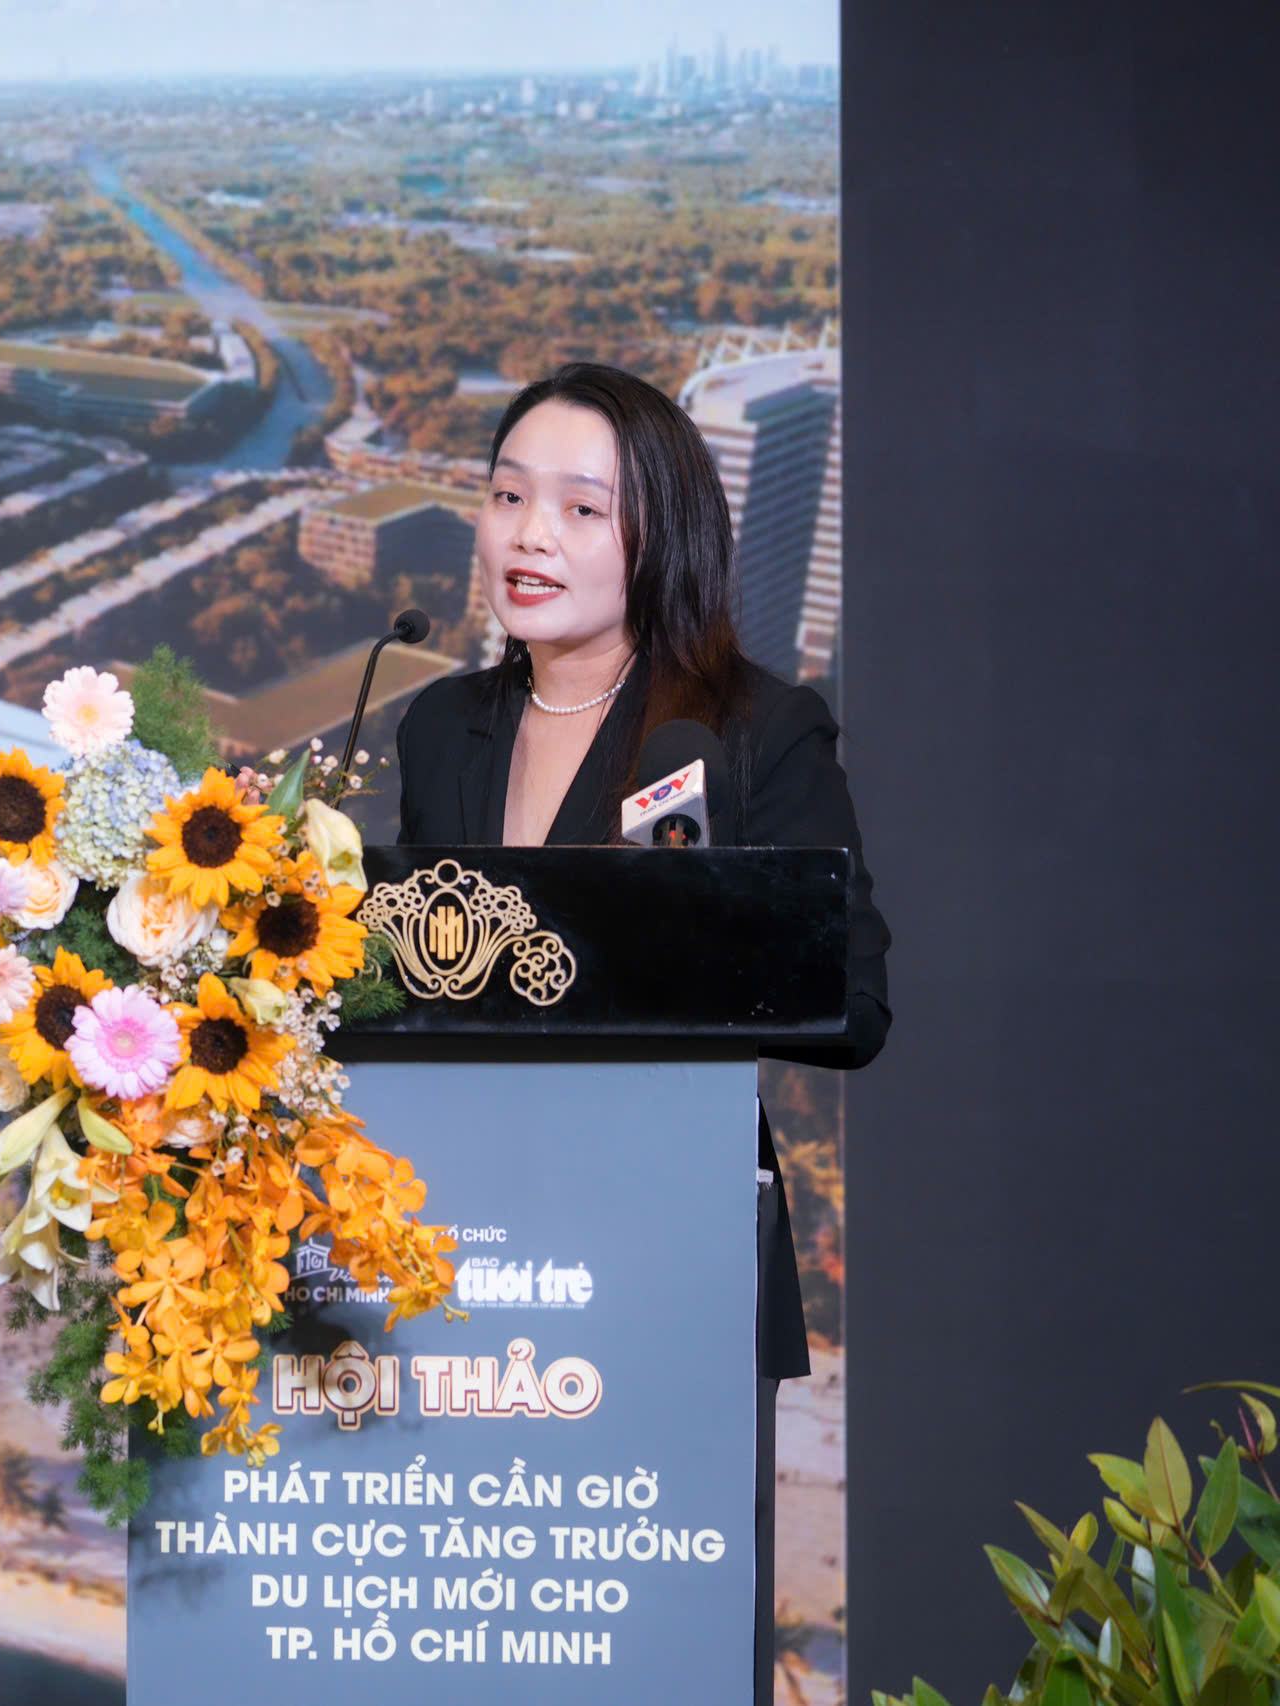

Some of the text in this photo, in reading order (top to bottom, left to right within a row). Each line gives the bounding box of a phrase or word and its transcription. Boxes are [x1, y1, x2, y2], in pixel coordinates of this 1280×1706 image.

[635, 772, 690, 809] VOV
[462, 1225, 507, 1243] CHỨC
[273, 1337, 603, 1431] HỘI THẢO
[224, 1454, 660, 1510] PHÁT TRIỂN CẦN GIỜ
[155, 1511, 727, 1567] THÀNH CỰC TĂNG TRƯỞNG
[251, 1567, 630, 1617] DU LỊCH MỚI CHO
[265, 1610, 612, 1665] TP. HỒ CHÍ MINH
